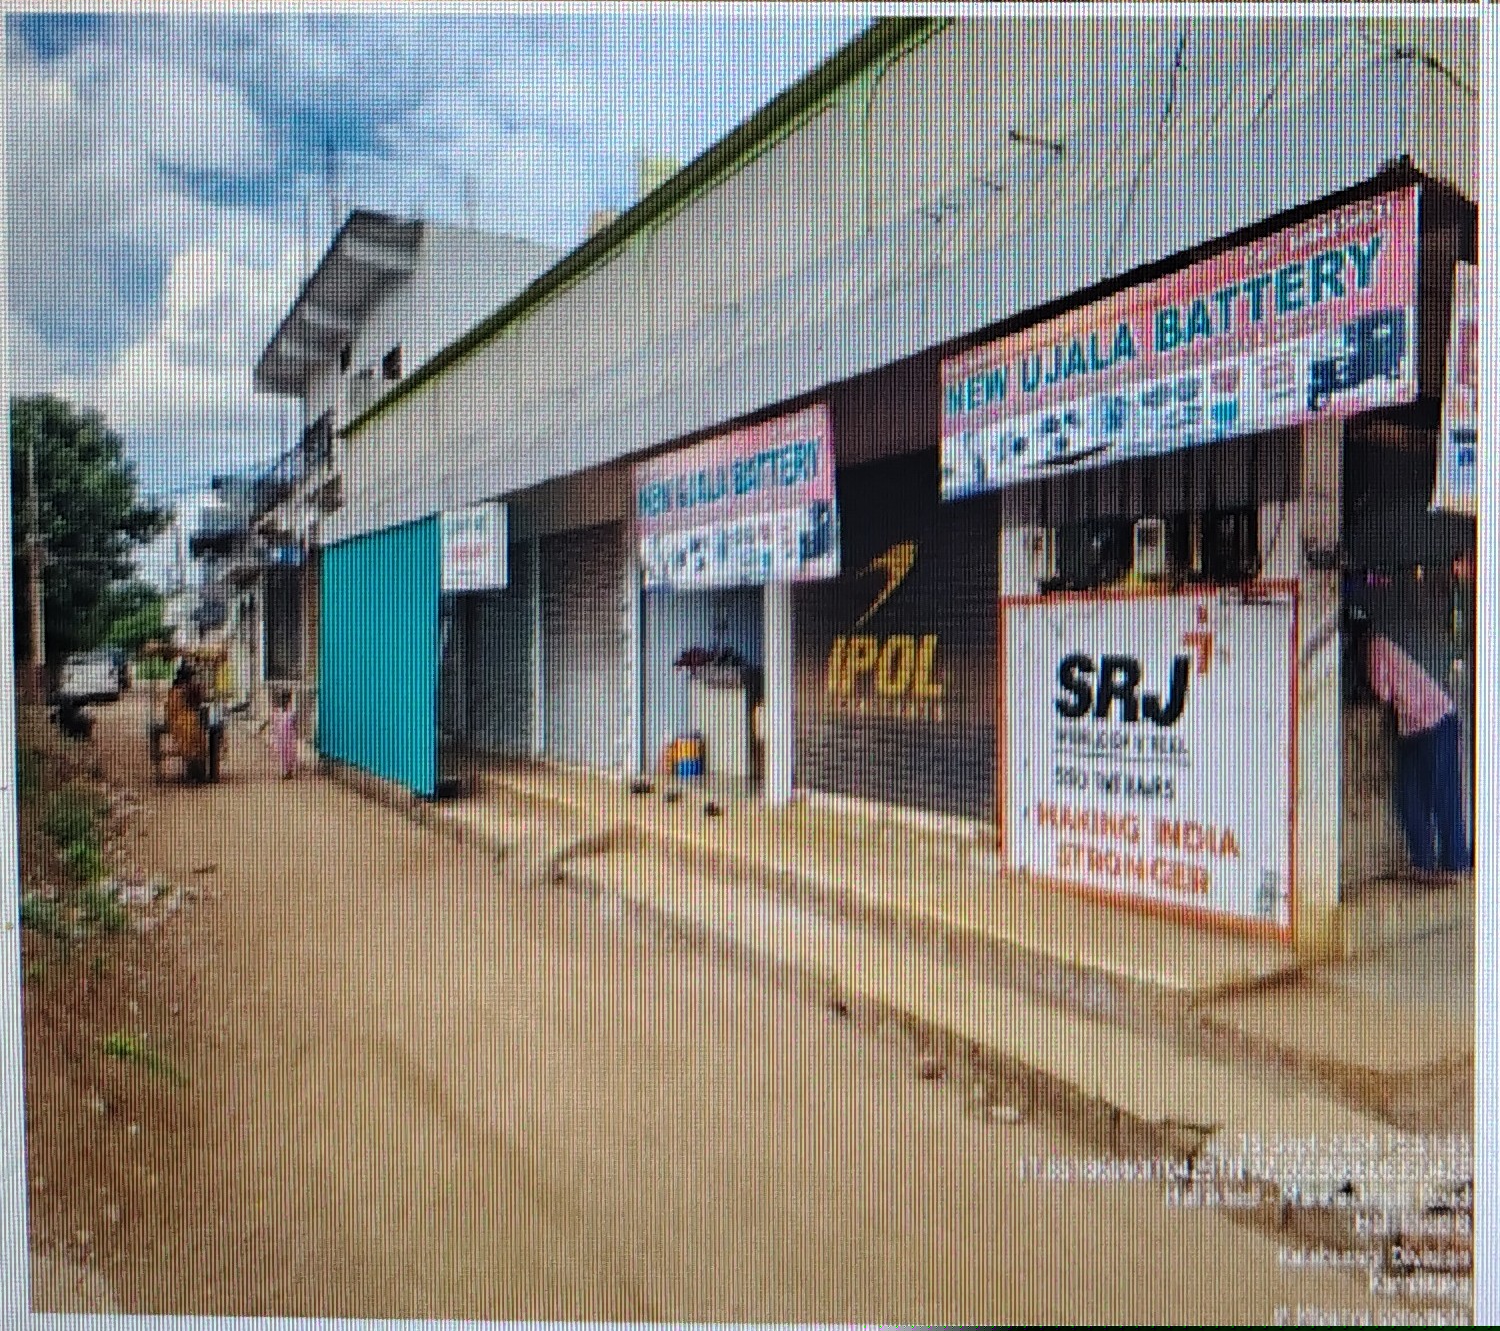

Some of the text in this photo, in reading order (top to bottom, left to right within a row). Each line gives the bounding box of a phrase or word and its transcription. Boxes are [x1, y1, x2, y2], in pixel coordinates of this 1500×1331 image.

[945, 363, 1010, 417] NEW
[1018, 321, 1136, 394] UJALA
[1155, 235, 1385, 354] BATTERY
[1054, 650, 1190, 727] SRJ
[1036, 800, 1239, 857] MAKING INDIA
[1056, 840, 1211, 895] STRONGER
